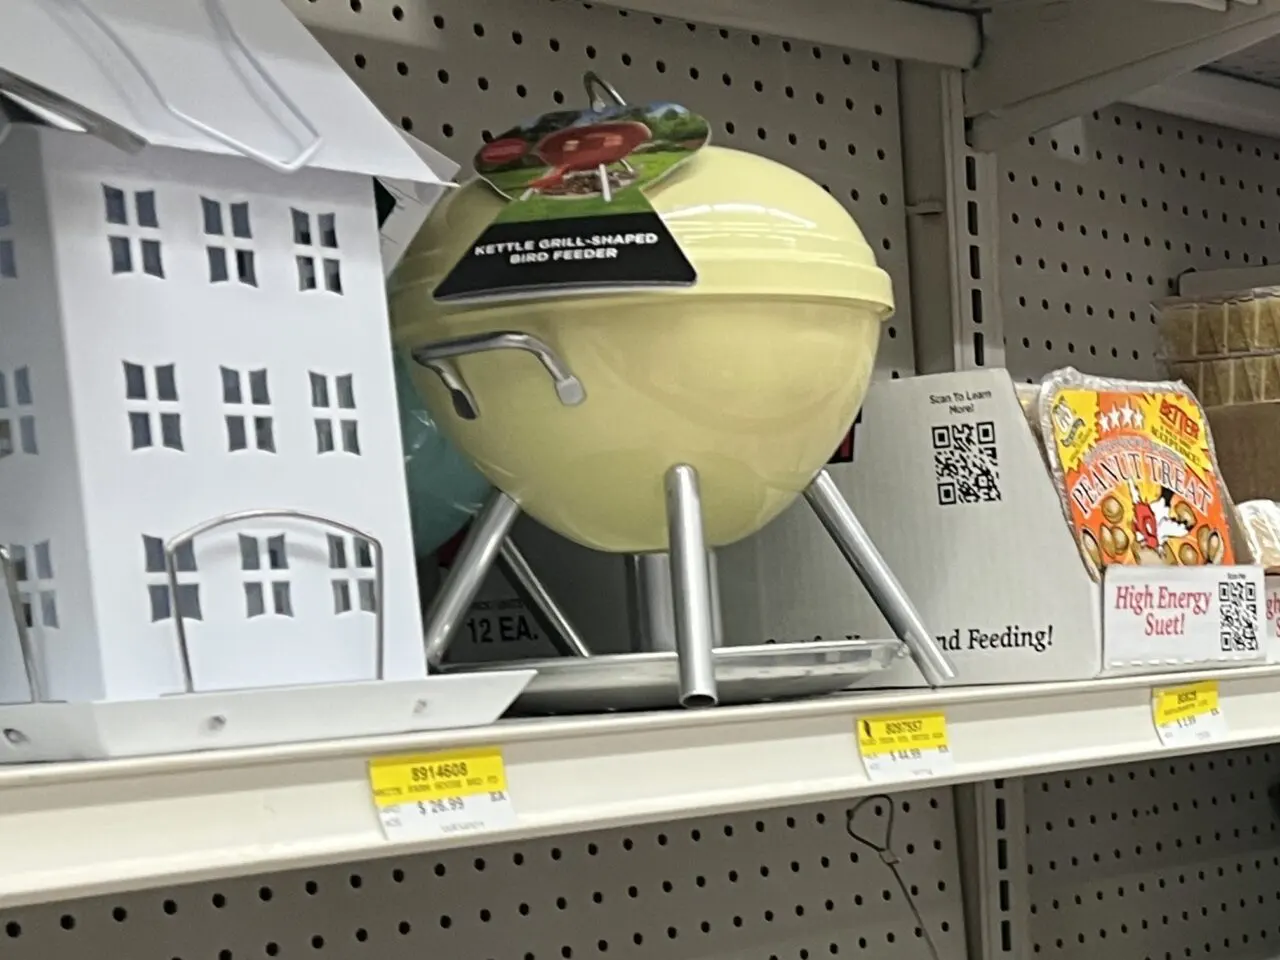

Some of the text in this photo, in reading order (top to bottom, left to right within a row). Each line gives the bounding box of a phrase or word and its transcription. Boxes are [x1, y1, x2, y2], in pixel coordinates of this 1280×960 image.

[475, 232, 659, 256] KETTLE GRILL-SHAPED
[509, 246, 618, 265] BIRD FEEDER
[929, 390, 992, 405] Scan To Learn
[948, 403, 975, 415] More!
[1071, 452, 1215, 521] PEANUT TREAT
[1115, 586, 1213, 616] High Energy
[467, 614, 538, 644] 12 EA.
[1144, 612, 1186, 636] Suet!
[968, 625, 1053, 653] Feeding!
[417, 800, 426, 815] $
